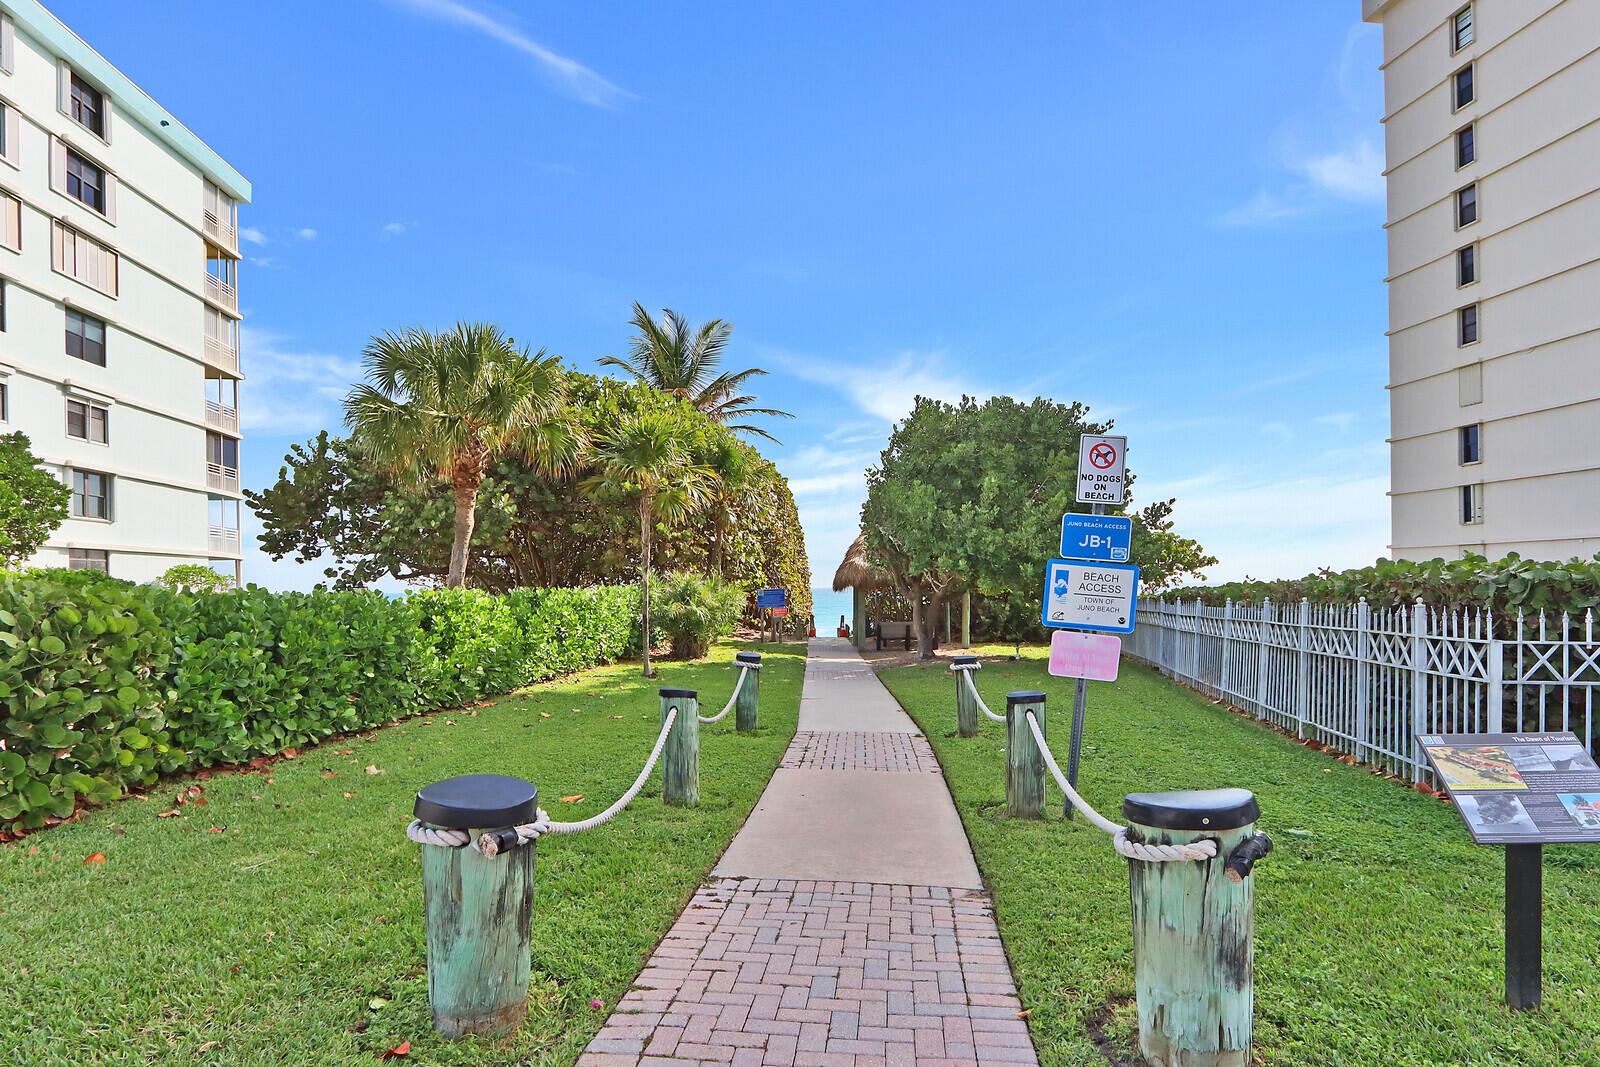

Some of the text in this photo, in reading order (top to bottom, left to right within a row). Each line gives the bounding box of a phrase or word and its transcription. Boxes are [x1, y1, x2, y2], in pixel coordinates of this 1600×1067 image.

[1081, 473, 1121, 483] NO DOGS
[1093, 483, 1107, 491] ON
[1084, 491, 1115, 500] BEACH
[1078, 534, 1112, 549] JB-1
[1083, 571, 1120, 583] BEACH
[1078, 582, 1122, 594] ACCESS
[1083, 596, 1104, 604] TOWN
[1077, 604, 1120, 613] JUNO BEACH
